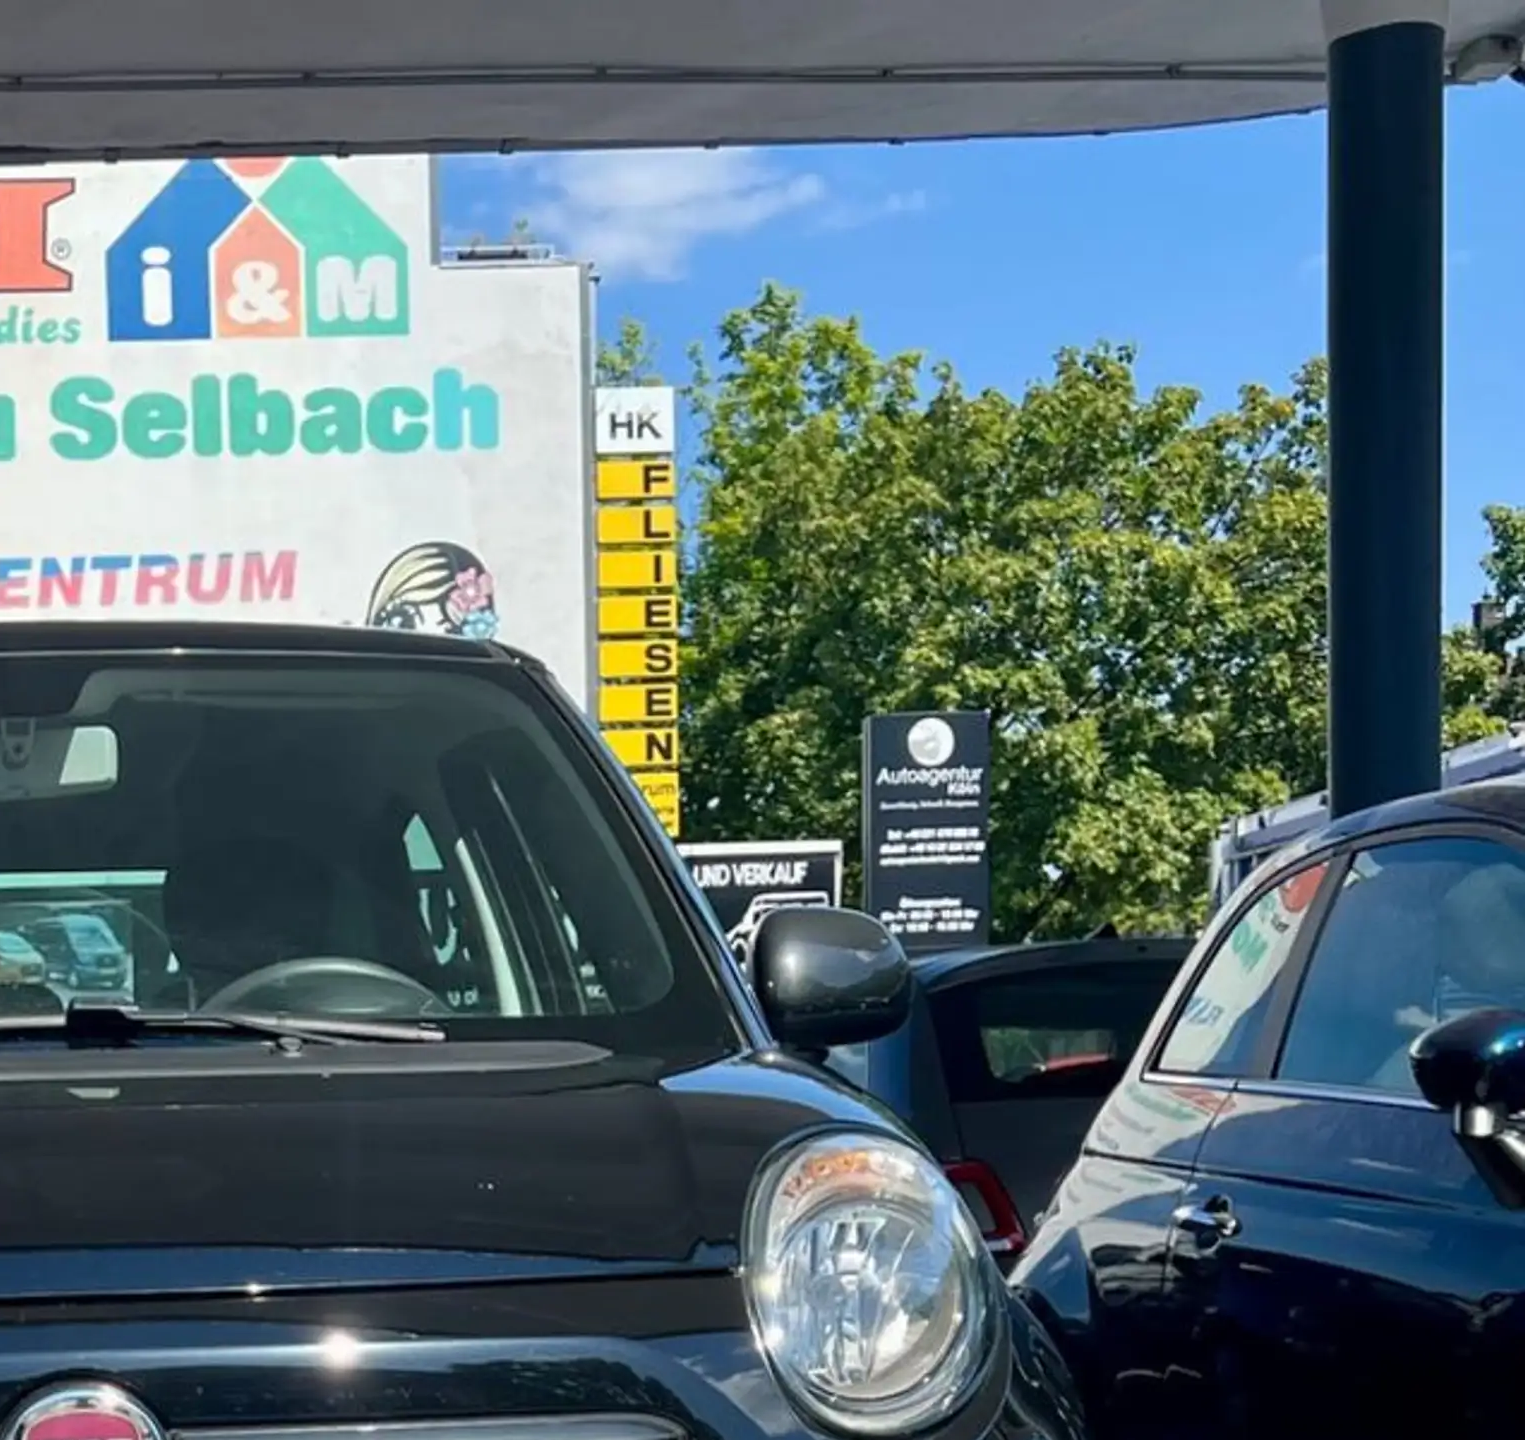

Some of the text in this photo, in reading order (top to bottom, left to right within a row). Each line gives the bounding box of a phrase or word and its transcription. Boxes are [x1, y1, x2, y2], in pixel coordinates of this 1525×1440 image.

[49, 366, 501, 461] Selbach
[607, 410, 663, 441] HK
[641, 463, 675, 763] FLIESEN
[876, 766, 983, 788] Autoagentur
[732, 860, 810, 887] VERKAUF
